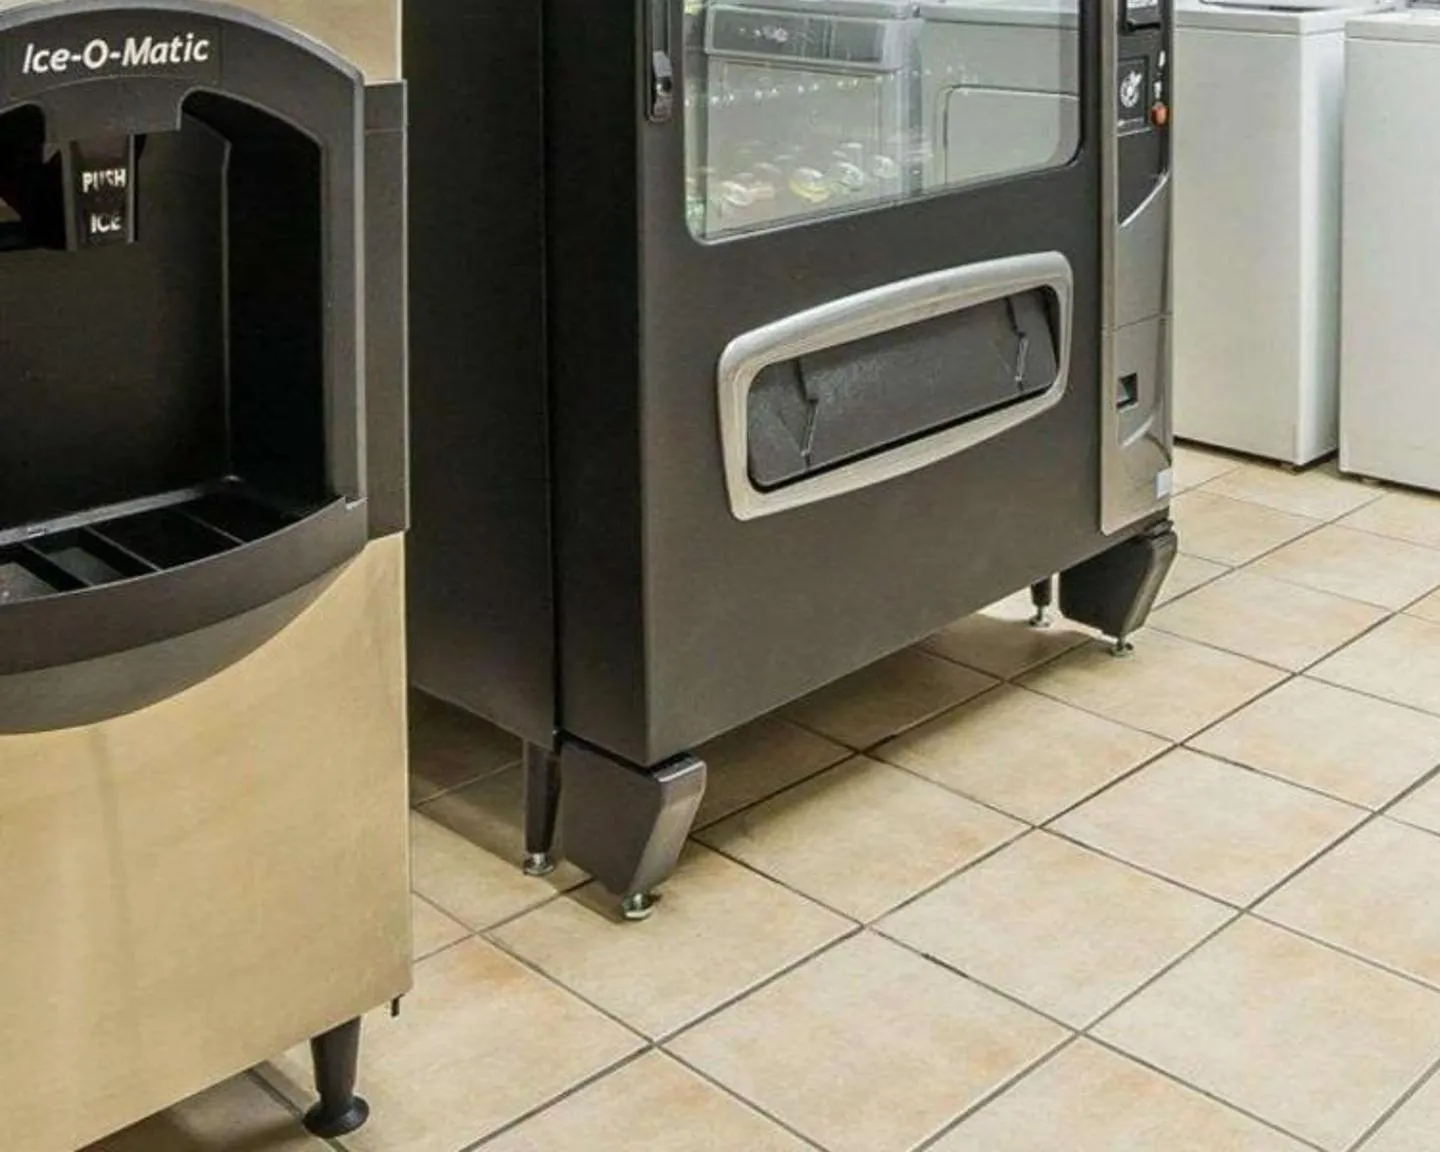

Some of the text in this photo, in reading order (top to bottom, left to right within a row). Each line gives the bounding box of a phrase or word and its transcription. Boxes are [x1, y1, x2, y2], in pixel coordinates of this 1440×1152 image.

[22, 32, 210, 74] Ice-O-Matic
[82, 168, 126, 193] PUSH
[91, 213, 121, 234] ICE
